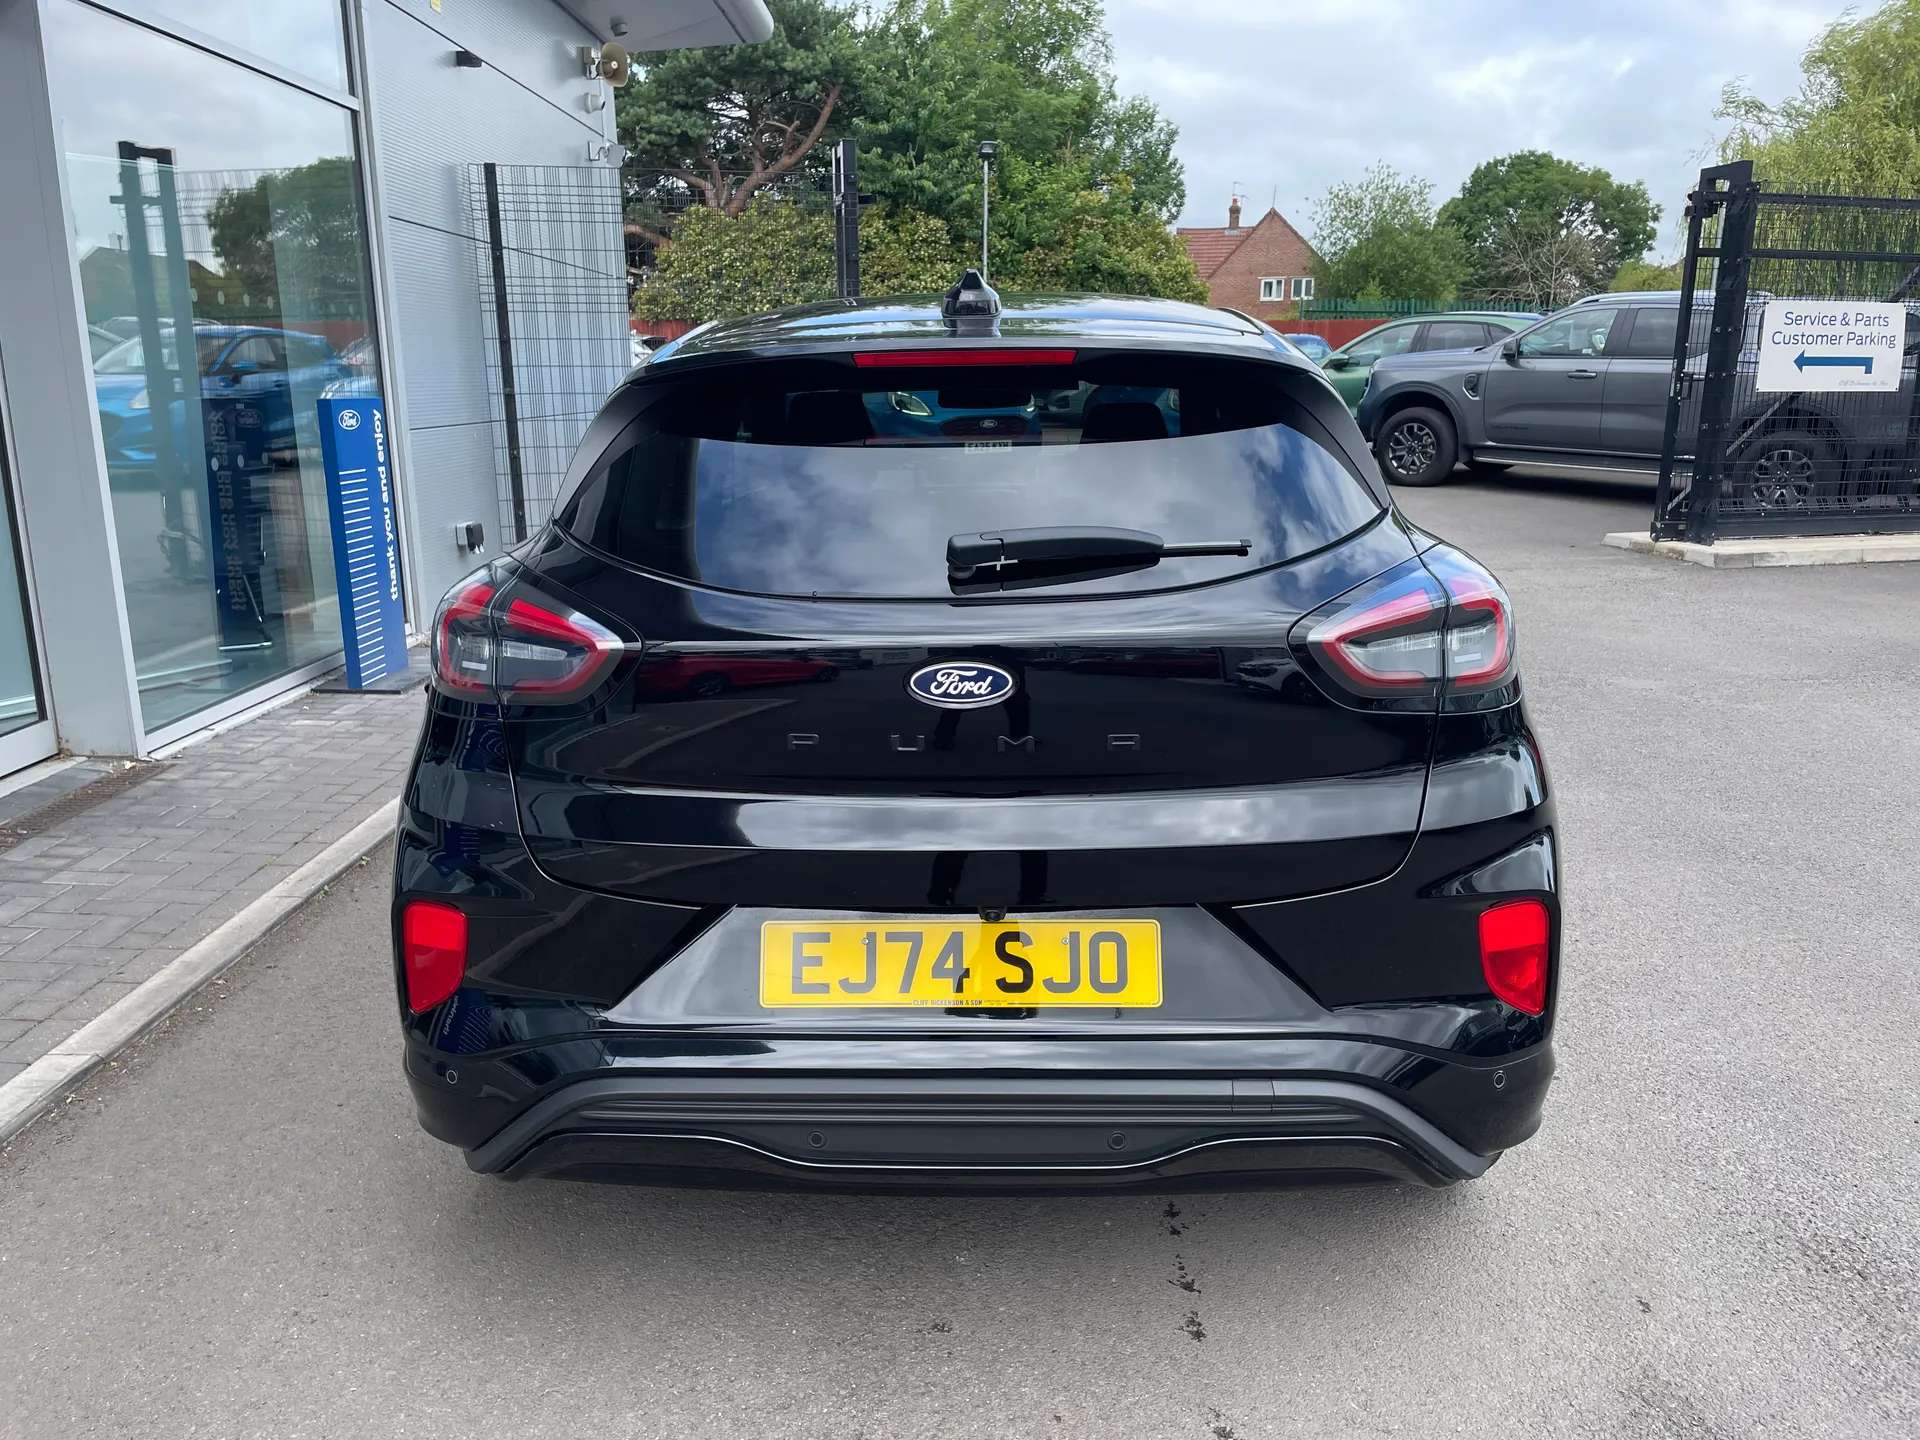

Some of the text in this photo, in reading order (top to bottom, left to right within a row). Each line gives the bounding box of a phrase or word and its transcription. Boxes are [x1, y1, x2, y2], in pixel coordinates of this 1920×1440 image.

[1784, 311, 1889, 327] Service & Parts
[1772, 331, 1896, 349] Customer Parking
[373, 409, 398, 601] thank you and enjoy
[930, 669, 992, 695] Ford
[787, 733, 1141, 752] PUMA
[791, 931, 1128, 995] EJ74 SJO
